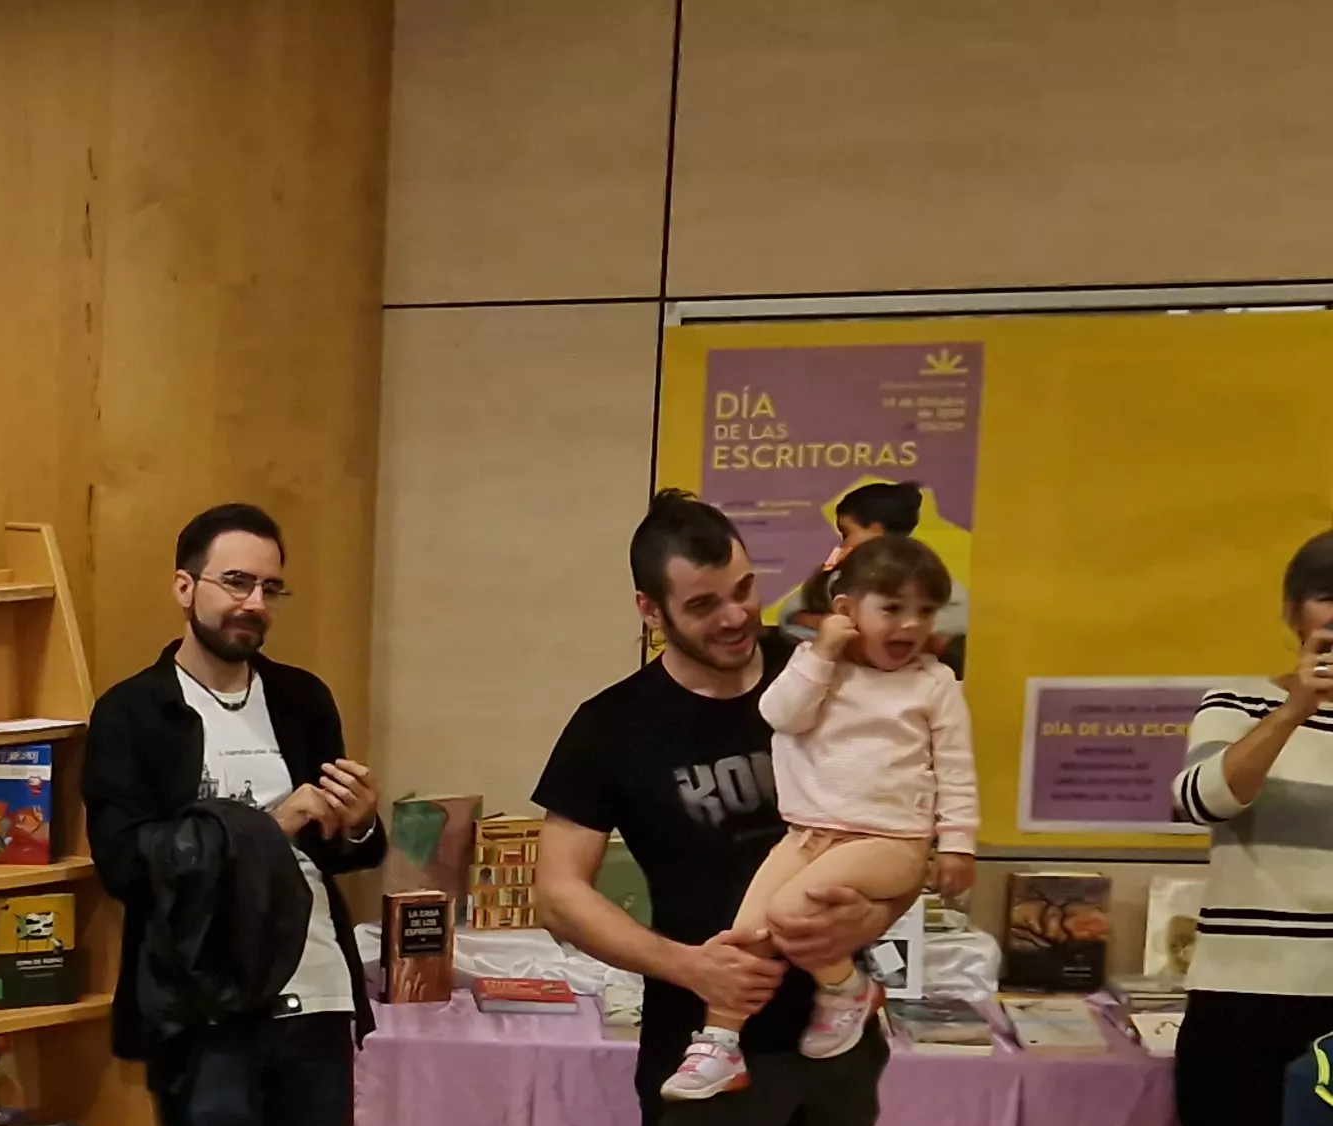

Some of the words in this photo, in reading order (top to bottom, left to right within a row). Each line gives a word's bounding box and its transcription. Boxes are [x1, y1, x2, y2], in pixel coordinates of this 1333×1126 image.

[716, 386, 776, 419] DÍA
[714, 424, 741, 440] DE
[748, 423, 789, 439] LAS
[712, 441, 919, 470] ESCRITORAS
[1041, 720, 1073, 737] DÍA
[1106, 722, 1137, 736] LAS
